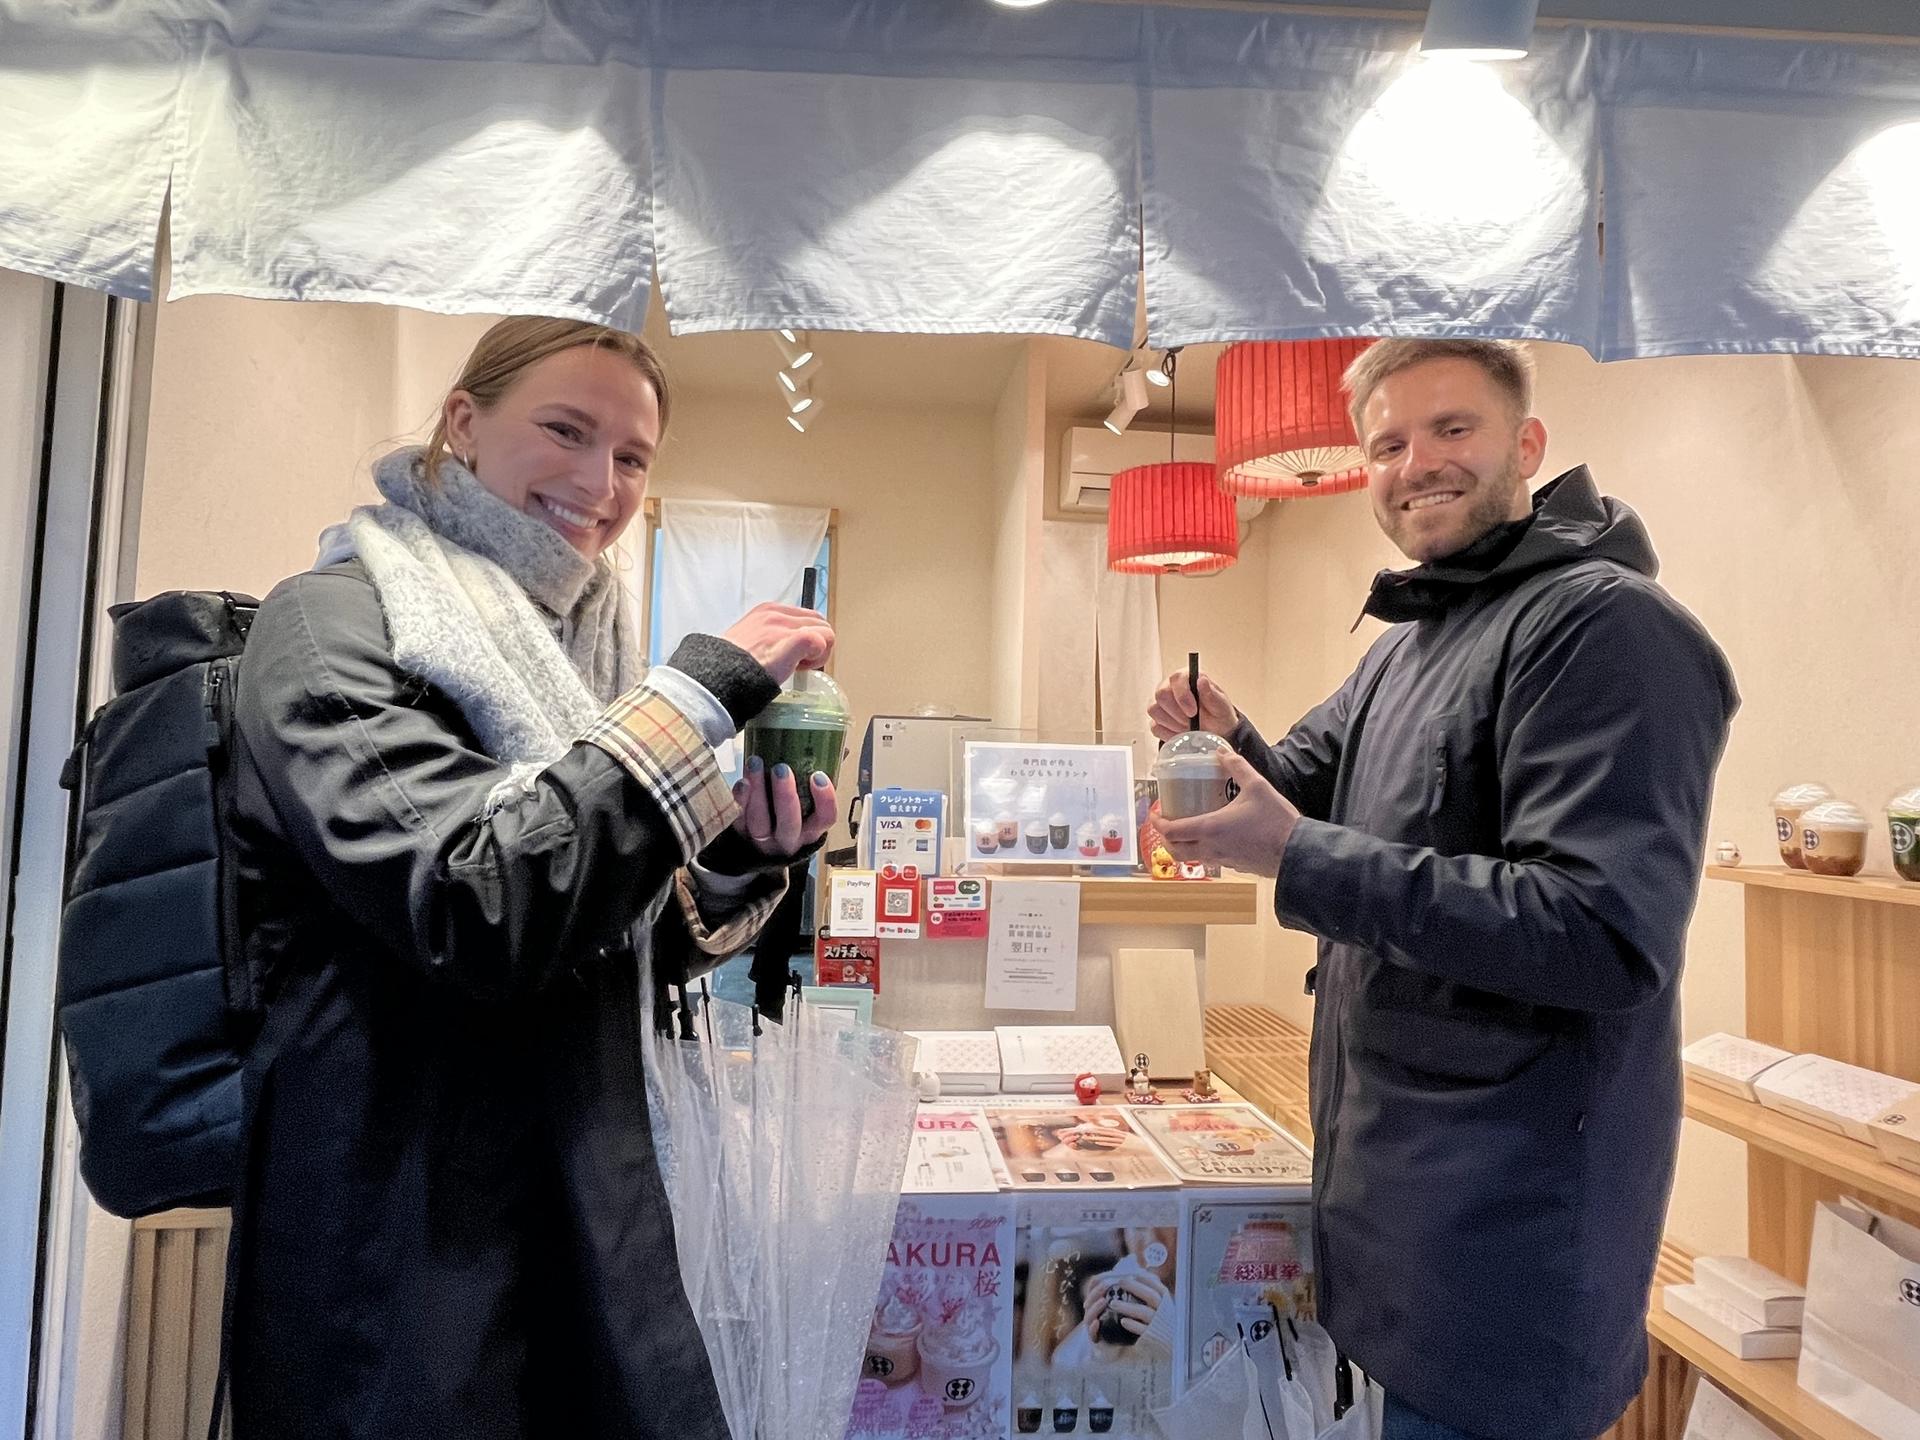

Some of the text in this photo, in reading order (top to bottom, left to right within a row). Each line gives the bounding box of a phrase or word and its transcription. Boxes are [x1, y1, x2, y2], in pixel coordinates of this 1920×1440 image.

[880, 795, 935, 805] クレジットカード
[880, 820, 903, 829] VISA
[847, 880, 871, 888] PayPay
[917, 1120, 979, 1131] URA
[885, 1241, 1001, 1267] AKURA
